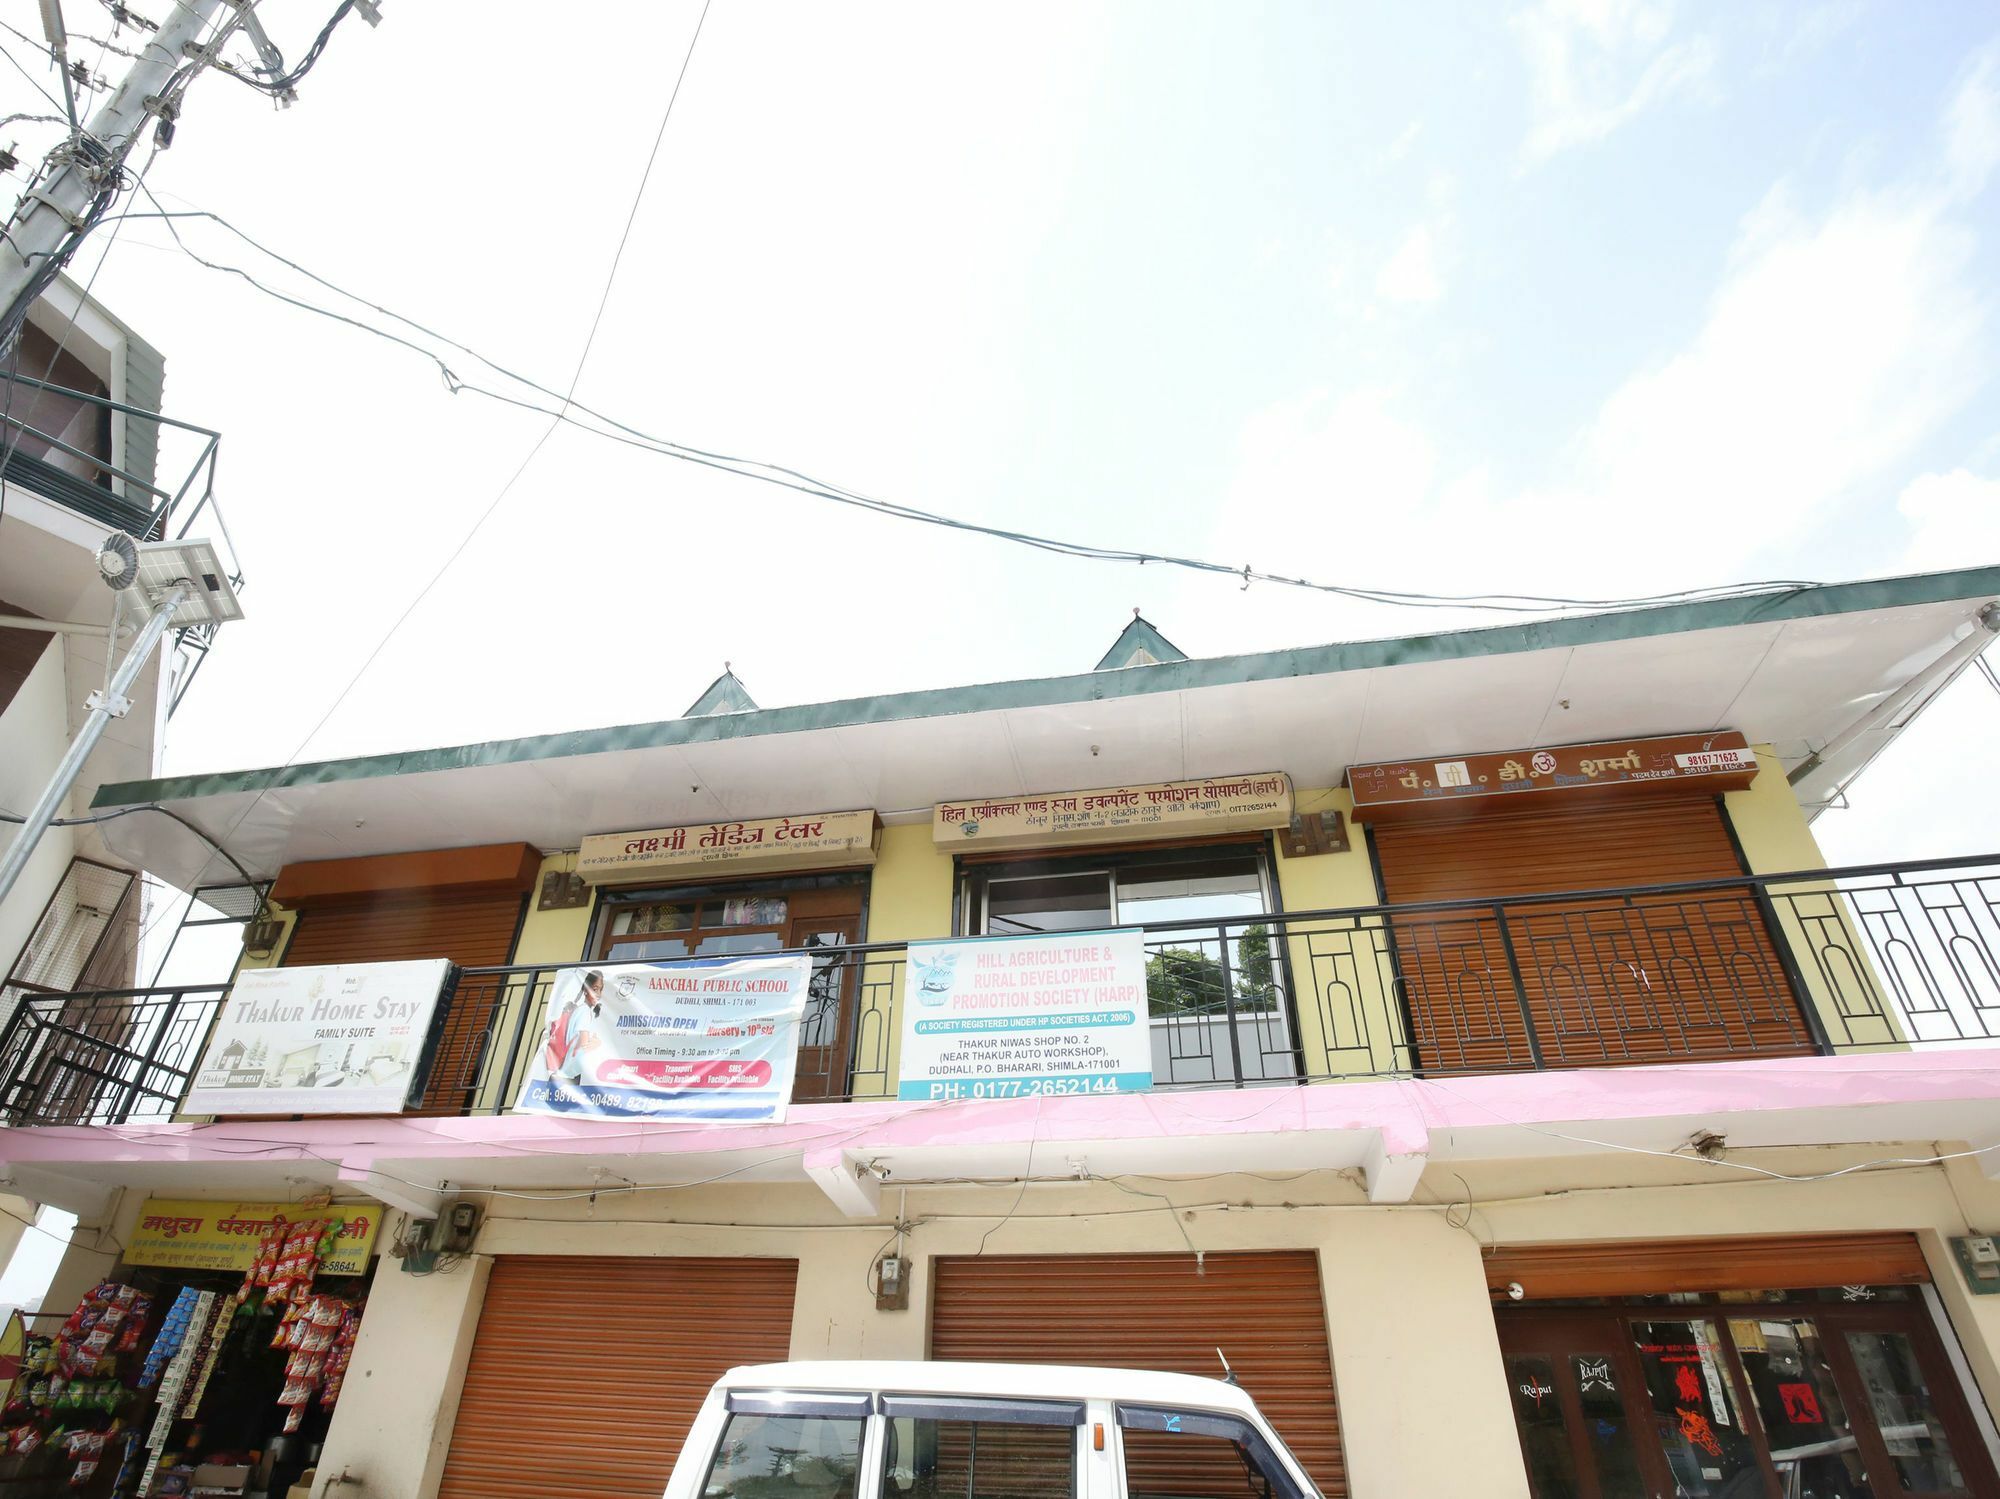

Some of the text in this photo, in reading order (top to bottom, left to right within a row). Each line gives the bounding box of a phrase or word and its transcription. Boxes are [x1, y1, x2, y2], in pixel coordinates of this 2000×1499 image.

[1579, 749, 1641, 777] शर्मा
[1687, 752, 1739, 766] 98167 71623
[940, 805, 967, 824] हिल
[971, 800, 1021, 822] एग्रीकल्चर
[1145, 784, 1200, 804] परमोशन
[1229, 801, 1278, 813] 01772652144
[624, 828, 687, 854] लक्ष्मी
[699, 823, 765, 848] लेडिज
[775, 819, 826, 840] टेलर
[977, 946, 1112, 968] HILL AGRICULTURE &
[649, 977, 700, 992] AANCHAL
[702, 979, 742, 993] PUBLIC
[745, 979, 790, 993] SCHOOL
[974, 966, 1117, 989] RURAL DEVELOPMENT
[702, 997, 727, 1006] SHIMLA
[732, 998, 743, 1006] 171
[745, 998, 757, 1006] 003
[953, 992, 1032, 1009] PROMOTION
[1034, 988, 1090, 1006] SOCIETY
[1094, 986, 1140, 1007] (HARP)
[616, 1015, 675, 1029] ADMISSIONS
[675, 1017, 699, 1030] OPEN
[919, 1021, 927, 1031] (A
[928, 1020, 960, 1030] SOCIETY
[961, 1018, 1009, 1029] REGISTERED
[1010, 1017, 1037, 1027] UNDER
[1038, 1017, 1049, 1026] HP
[1050, 1015, 1090, 1026] SOCIETIES
[314, 1027, 376, 1039] FAMILY SUITE
[706, 1025, 740, 1038] Nursery
[958, 1035, 1089, 1049] THAKUR NIWAS SHOP NO. 2
[636, 1047, 653, 1055] Office
[654, 1047, 676, 1058] Timing
[681, 1047, 696, 1057] 9:30
[708, 1048, 715, 1056] to
[730, 1049, 741, 1058] pm
[939, 1051, 969, 1062] (NEAR
[972, 1050, 1012, 1060] THAKUR
[1014, 1048, 1041, 1059] AUTO
[665, 1064, 693, 1074] Transport
[728, 1064, 742, 1073] SMS
[928, 1059, 1121, 1075] DUDHALI, P.O. BHARARI, SHIMLA-171001
[246, 1073, 262, 1083] STAY
[653, 1075, 674, 1084] Facility
[708, 1075, 729, 1084] Facility
[929, 1077, 1119, 1099] PH: 0177-2652144
[591, 1092, 623, 1108] 30489,
[142, 1215, 204, 1238] मथुरा
[1580, 1363, 1609, 1381] RAJPUT
